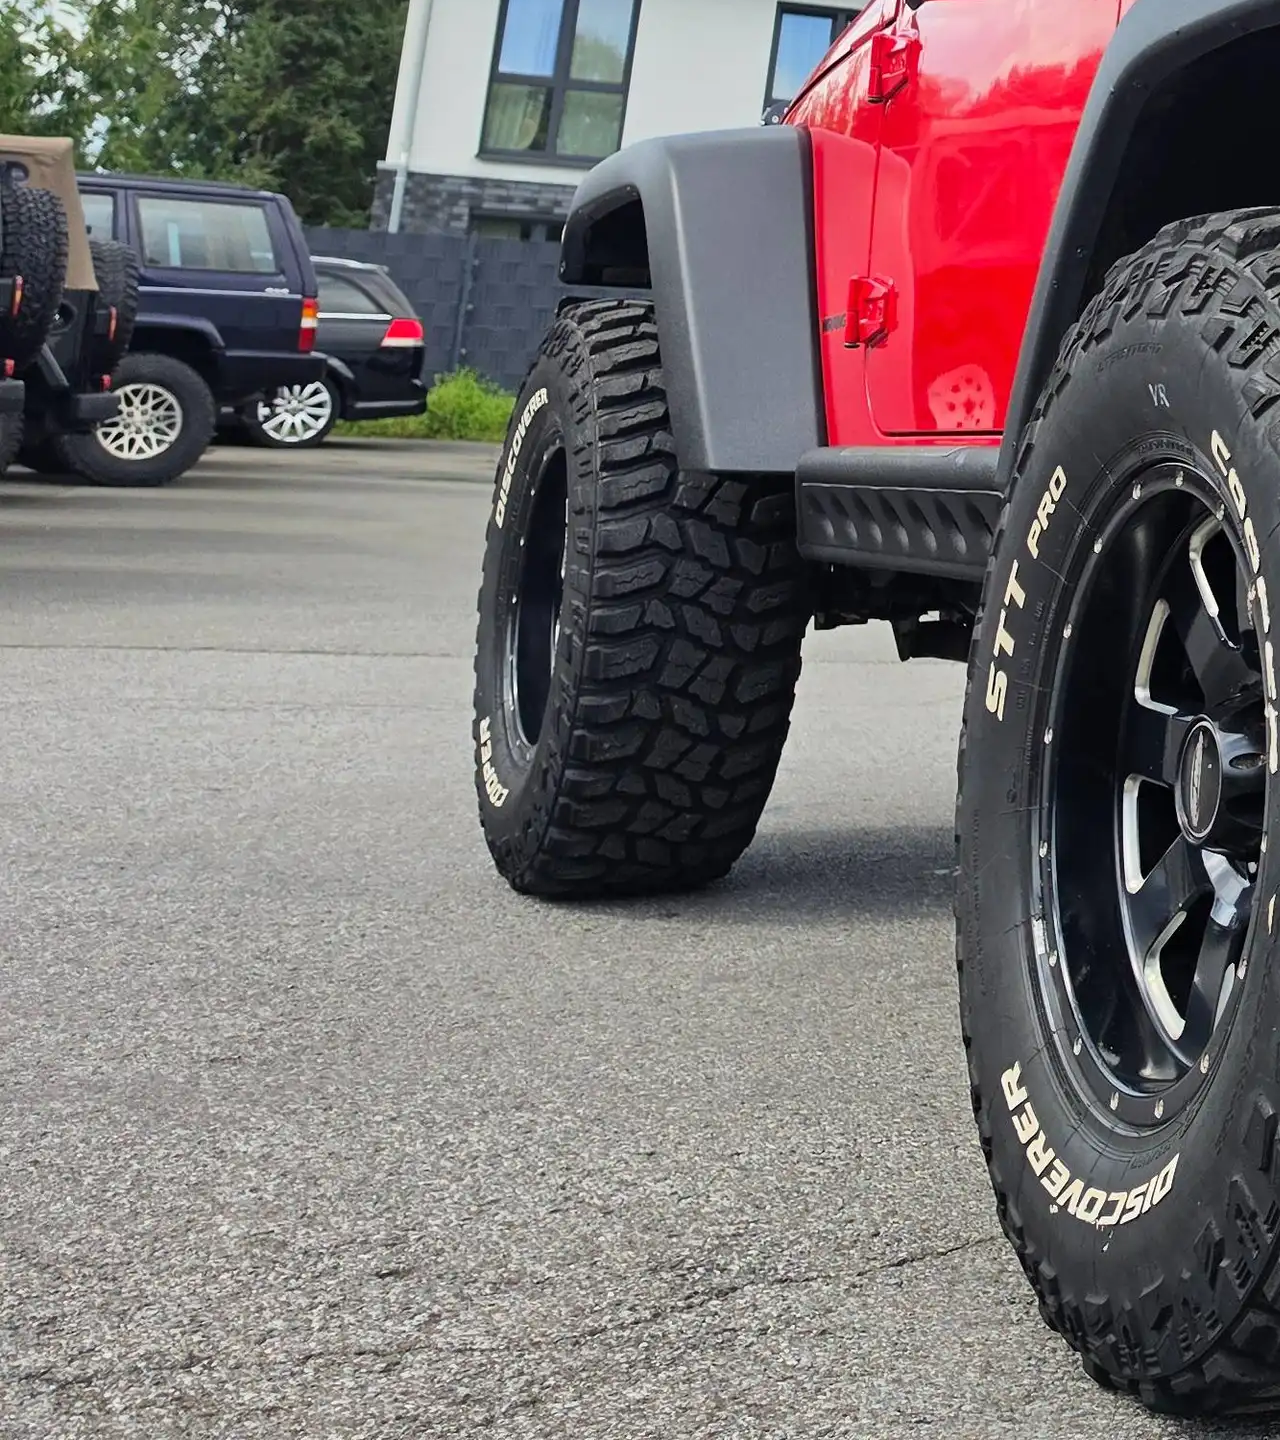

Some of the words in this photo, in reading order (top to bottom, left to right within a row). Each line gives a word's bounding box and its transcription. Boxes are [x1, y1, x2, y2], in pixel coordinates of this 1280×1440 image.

[495, 387, 548, 529] DISCOVERER
[985, 559, 1026, 722] STT
[1026, 464, 1068, 560] PRO
[479, 716, 510, 808] COOPER
[1000, 1060, 1180, 1226] DISCOVERER
